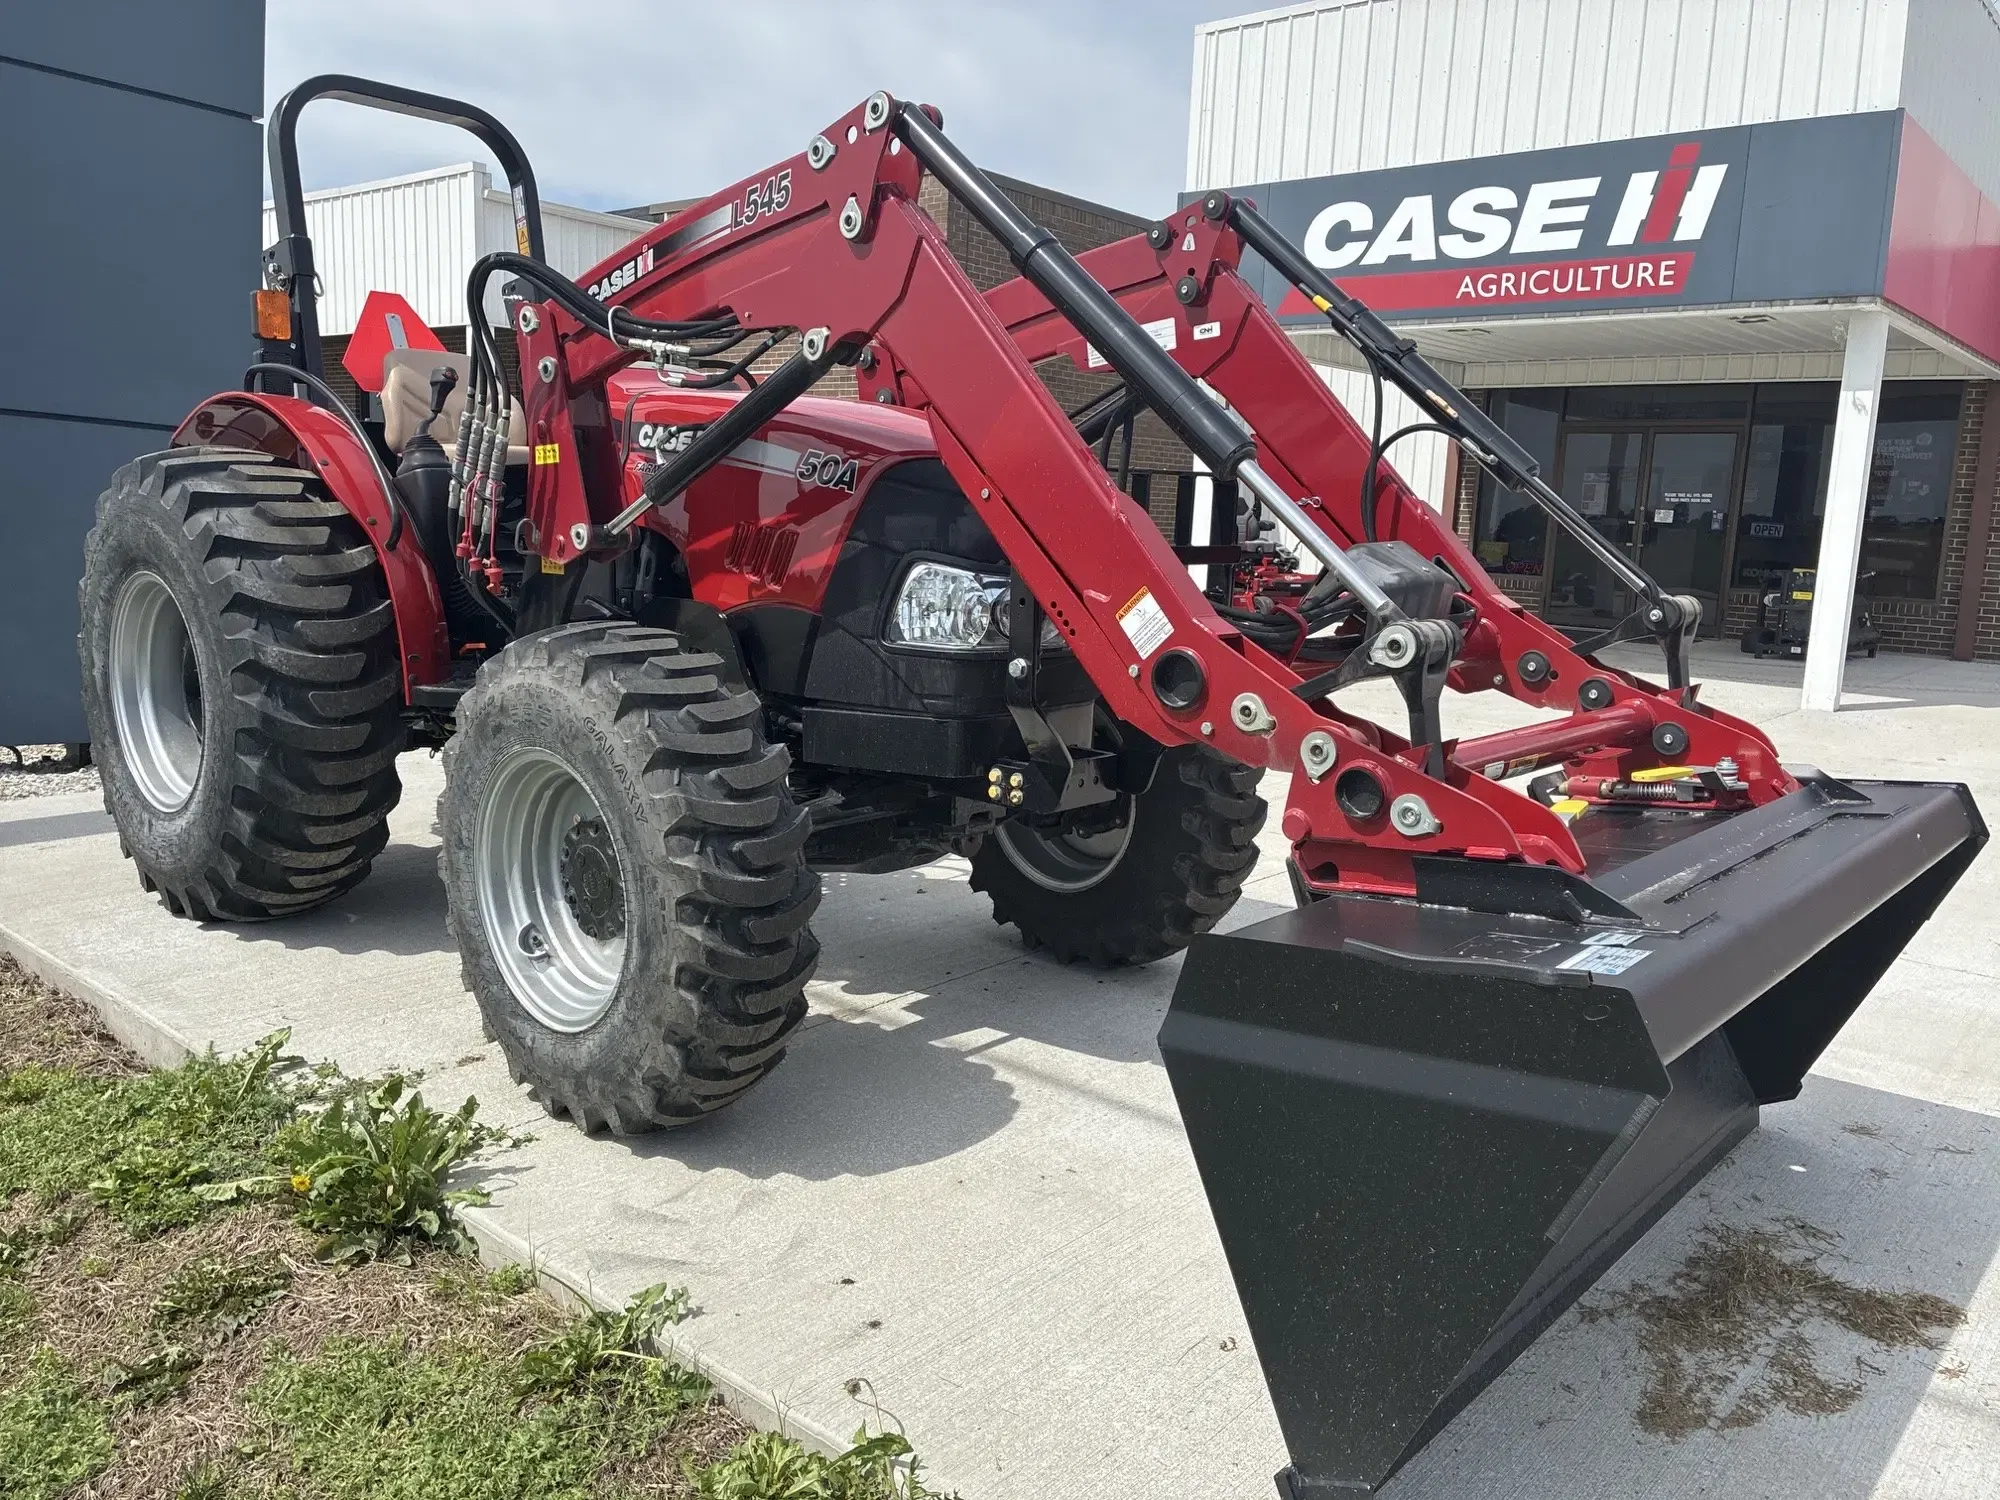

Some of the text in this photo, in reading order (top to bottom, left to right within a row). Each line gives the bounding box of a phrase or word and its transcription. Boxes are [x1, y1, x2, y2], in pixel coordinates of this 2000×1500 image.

[732, 168, 792, 231] L545
[1304, 176, 1602, 270] CASE
[587, 260, 635, 302] CASE
[1456, 260, 1677, 299] AGRICULTURE
[796, 449, 859, 493] 50A
[1754, 525, 1781, 537] OPEN
[1505, 561, 1543, 575] OPEN
[1122, 587, 1149, 615] WARNING
[583, 716, 649, 825] GALAXY
